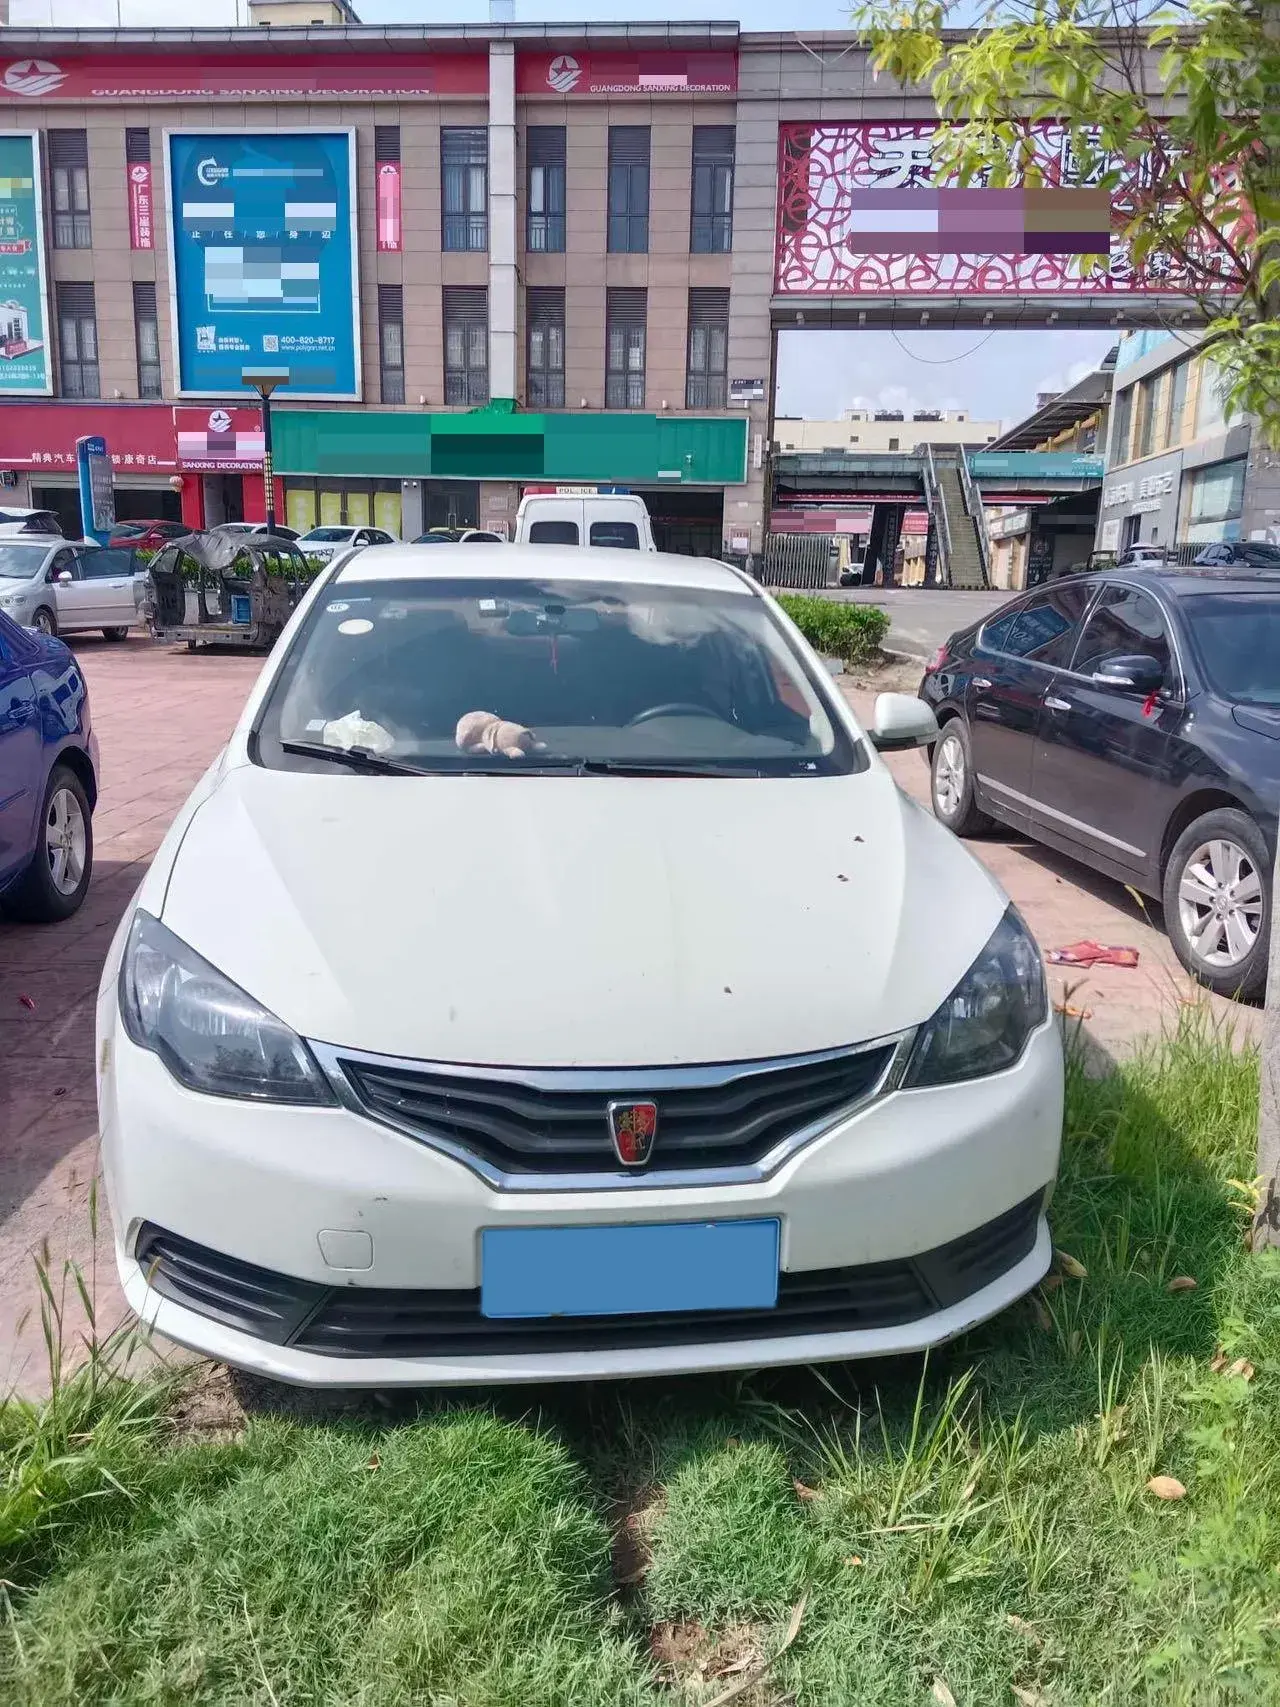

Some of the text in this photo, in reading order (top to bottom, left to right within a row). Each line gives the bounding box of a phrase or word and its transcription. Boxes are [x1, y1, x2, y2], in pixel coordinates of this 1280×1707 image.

[590, 84, 731, 92] GUANGDONG SANXING DECORATION
[281, 336, 336, 344] 400-820-8717
[182, 461, 263, 470] SANXING DECORATION
